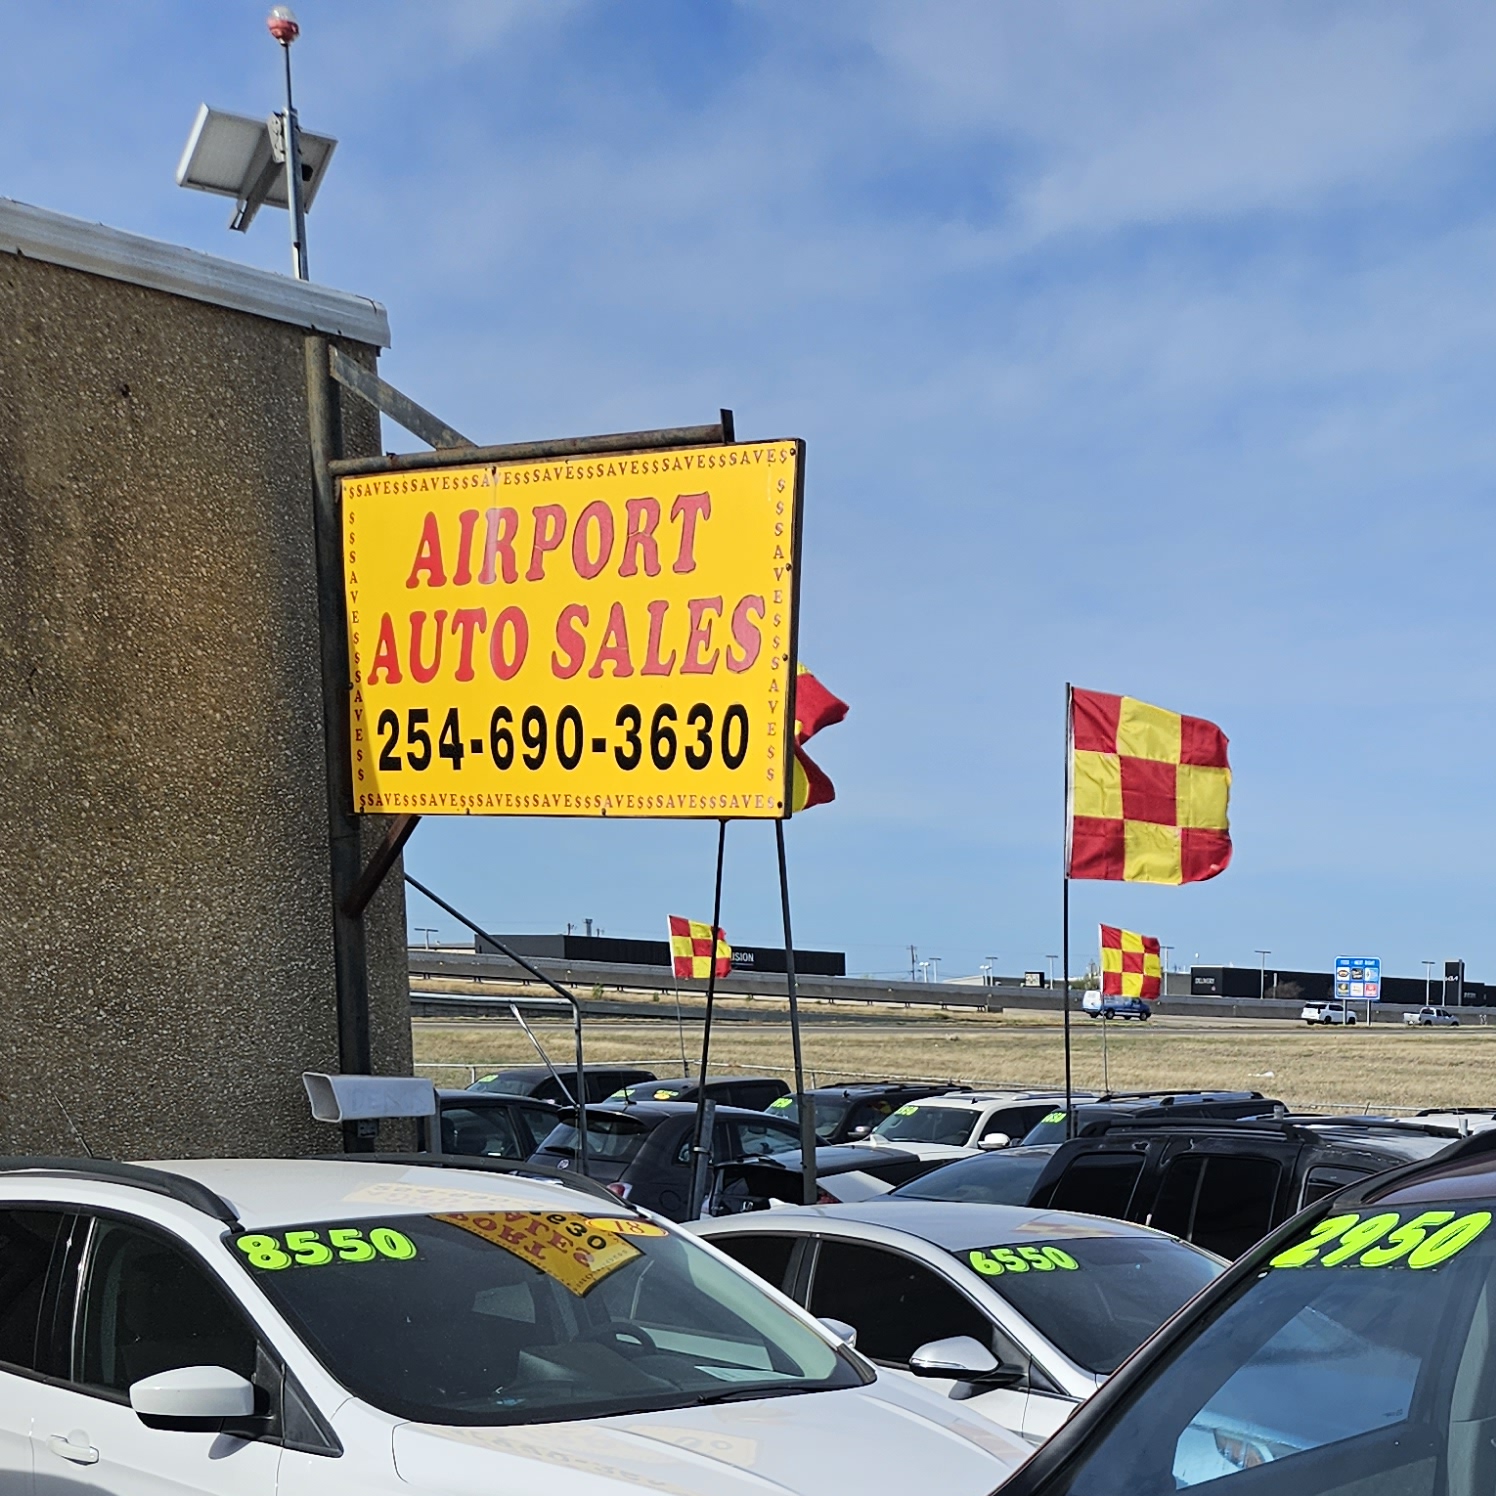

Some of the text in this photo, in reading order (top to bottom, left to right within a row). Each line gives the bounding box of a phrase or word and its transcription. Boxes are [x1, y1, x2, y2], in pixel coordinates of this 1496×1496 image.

[406, 491, 711, 588] AIRPORT
[367, 594, 766, 685] AUTO SALES
[377, 703, 749, 771] 254-690-3630
[731, 951, 755, 962] ISION
[236, 1226, 417, 1270] 8550
[968, 1246, 1080, 1276] 6550
[1269, 1211, 1493, 1269] 2950
